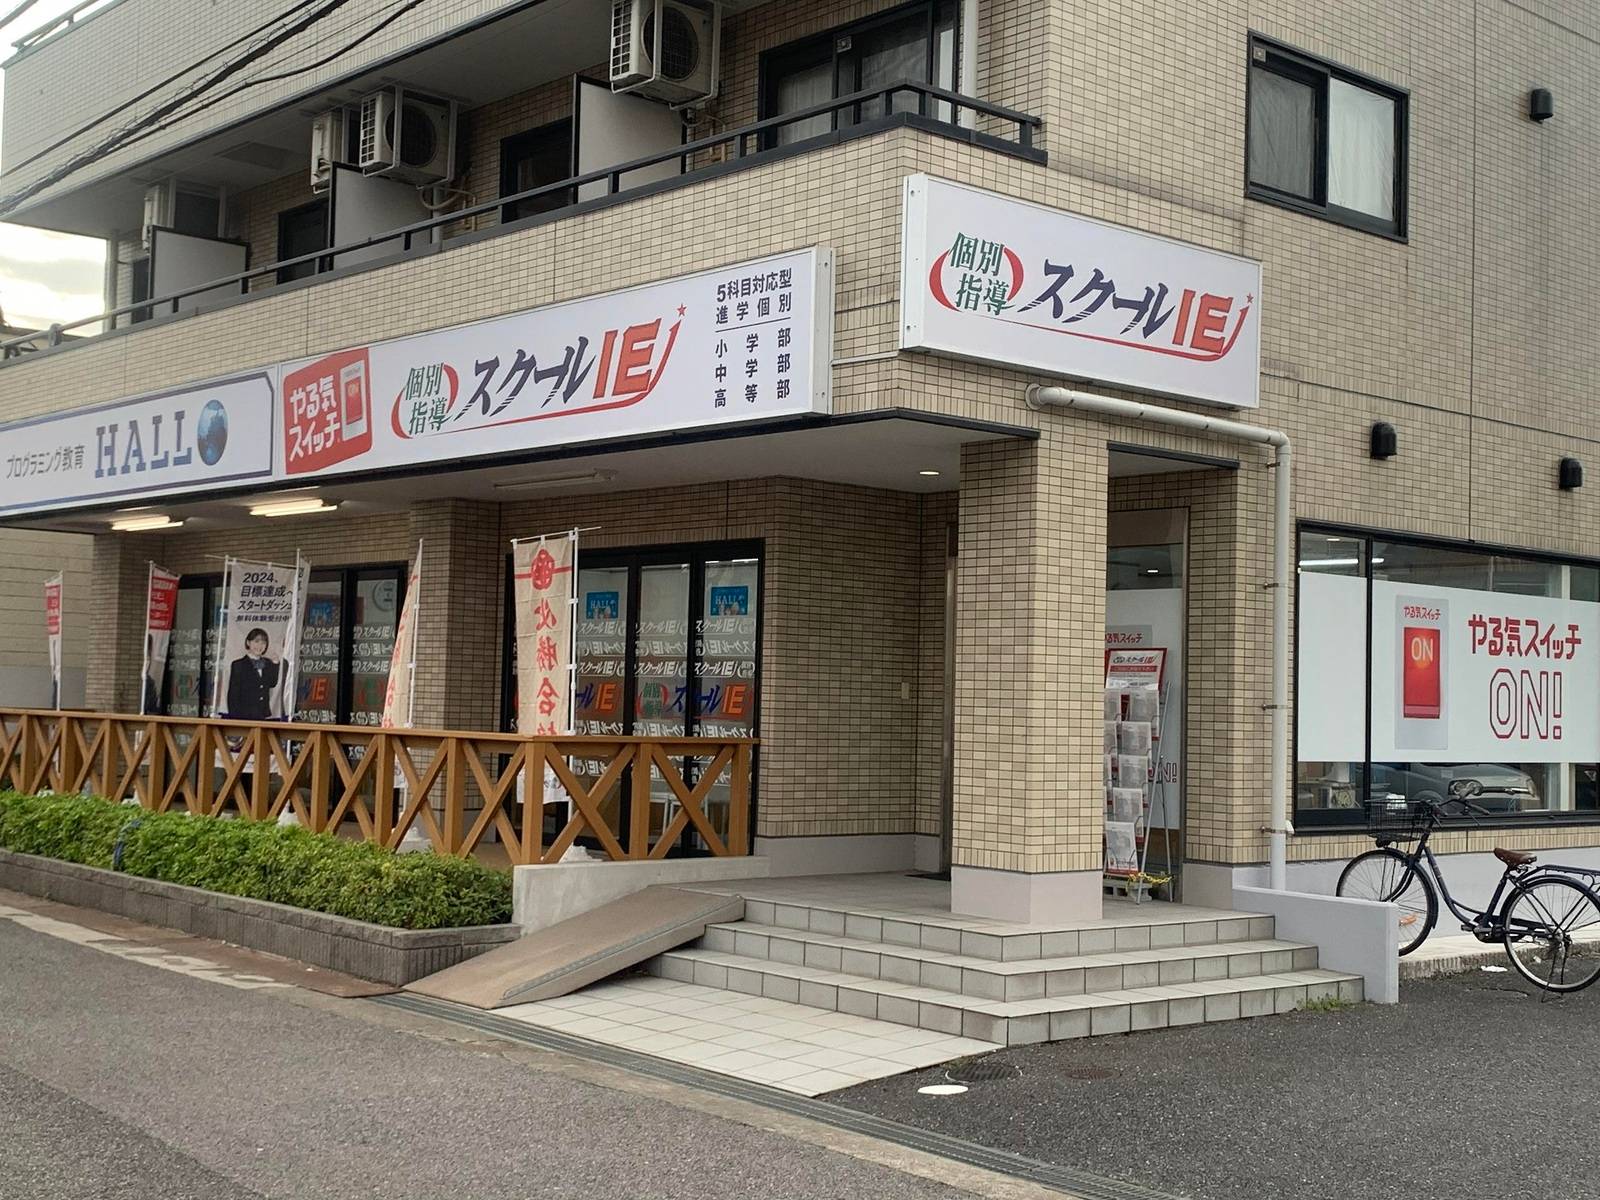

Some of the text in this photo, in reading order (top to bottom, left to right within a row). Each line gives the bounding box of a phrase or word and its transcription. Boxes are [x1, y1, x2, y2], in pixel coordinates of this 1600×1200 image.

[949, 231, 1004, 277] 個別
[716, 268, 792, 303] 5科目対応型
[955, 272, 1012, 316] 指導
[1017, 259, 1234, 354] スクールIE
[715, 292, 792, 325] 進学個別
[405, 362, 444, 401] 個別
[454, 317, 661, 421] スクールIE
[289, 374, 337, 426] やる気
[408, 397, 452, 435] 指導
[288, 411, 341, 462] スイッチ
[6, 444, 86, 479] プログラミング教育
[1403, 605, 1441, 620] やる気スイッチ
[1410, 637, 1433, 662] ON
[1467, 614, 1582, 660] やる気スイッチ
[1489, 668, 1562, 739] ON!
